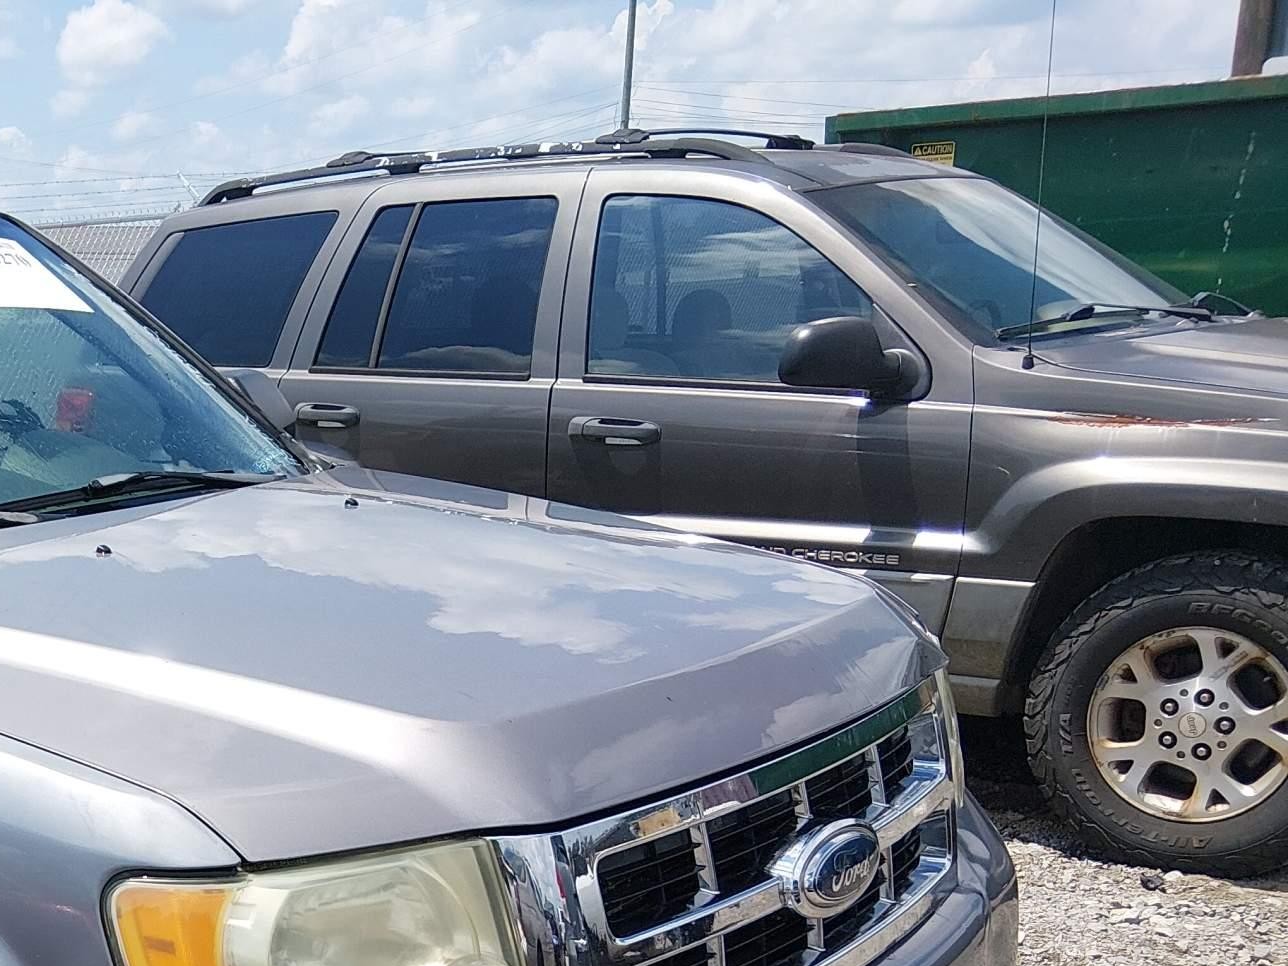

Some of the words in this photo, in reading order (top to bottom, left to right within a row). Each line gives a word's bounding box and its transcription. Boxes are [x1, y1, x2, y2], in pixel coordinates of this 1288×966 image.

[922, 145, 952, 155] CAUTION
[791, 548, 899, 565] CHEROKEE
[832, 846, 872, 892] Ford
